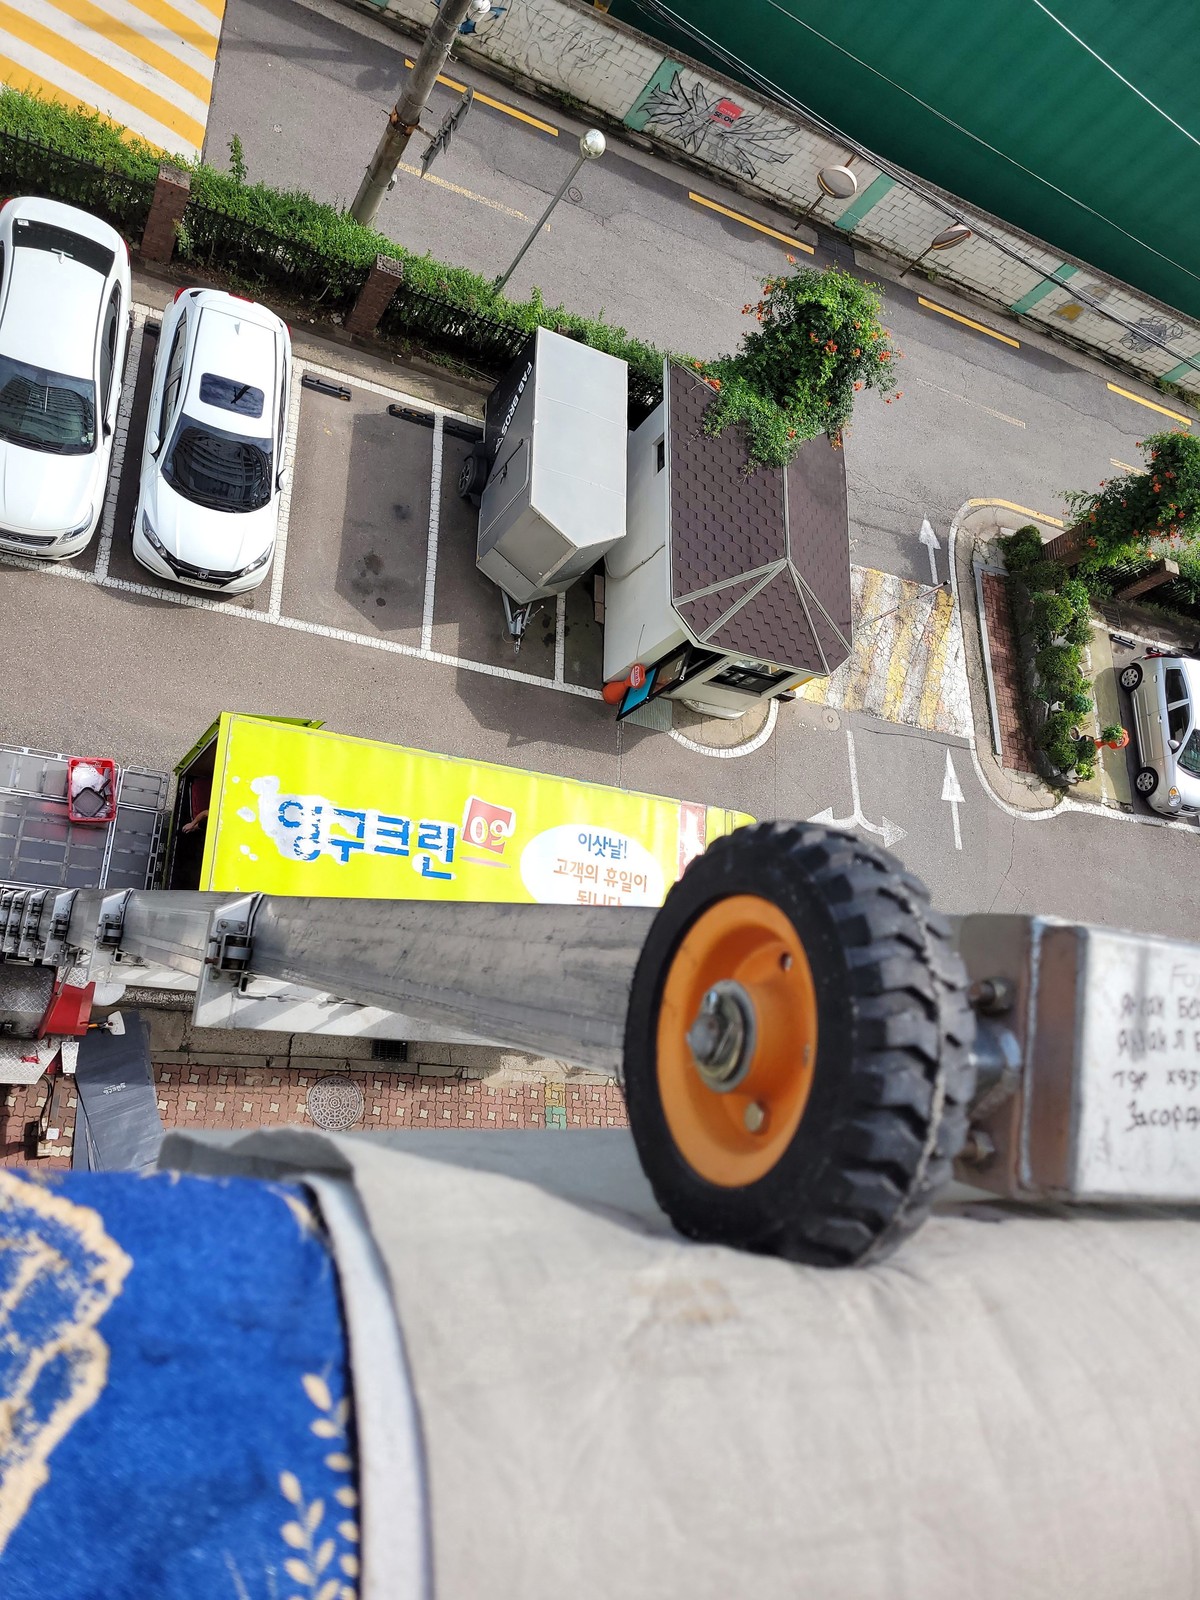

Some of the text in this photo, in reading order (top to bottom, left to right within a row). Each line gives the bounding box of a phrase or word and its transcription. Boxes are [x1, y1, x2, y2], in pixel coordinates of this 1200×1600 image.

[577, 832, 628, 860] 이삿날!
[552, 857, 648, 894] 고객의 휴일이
